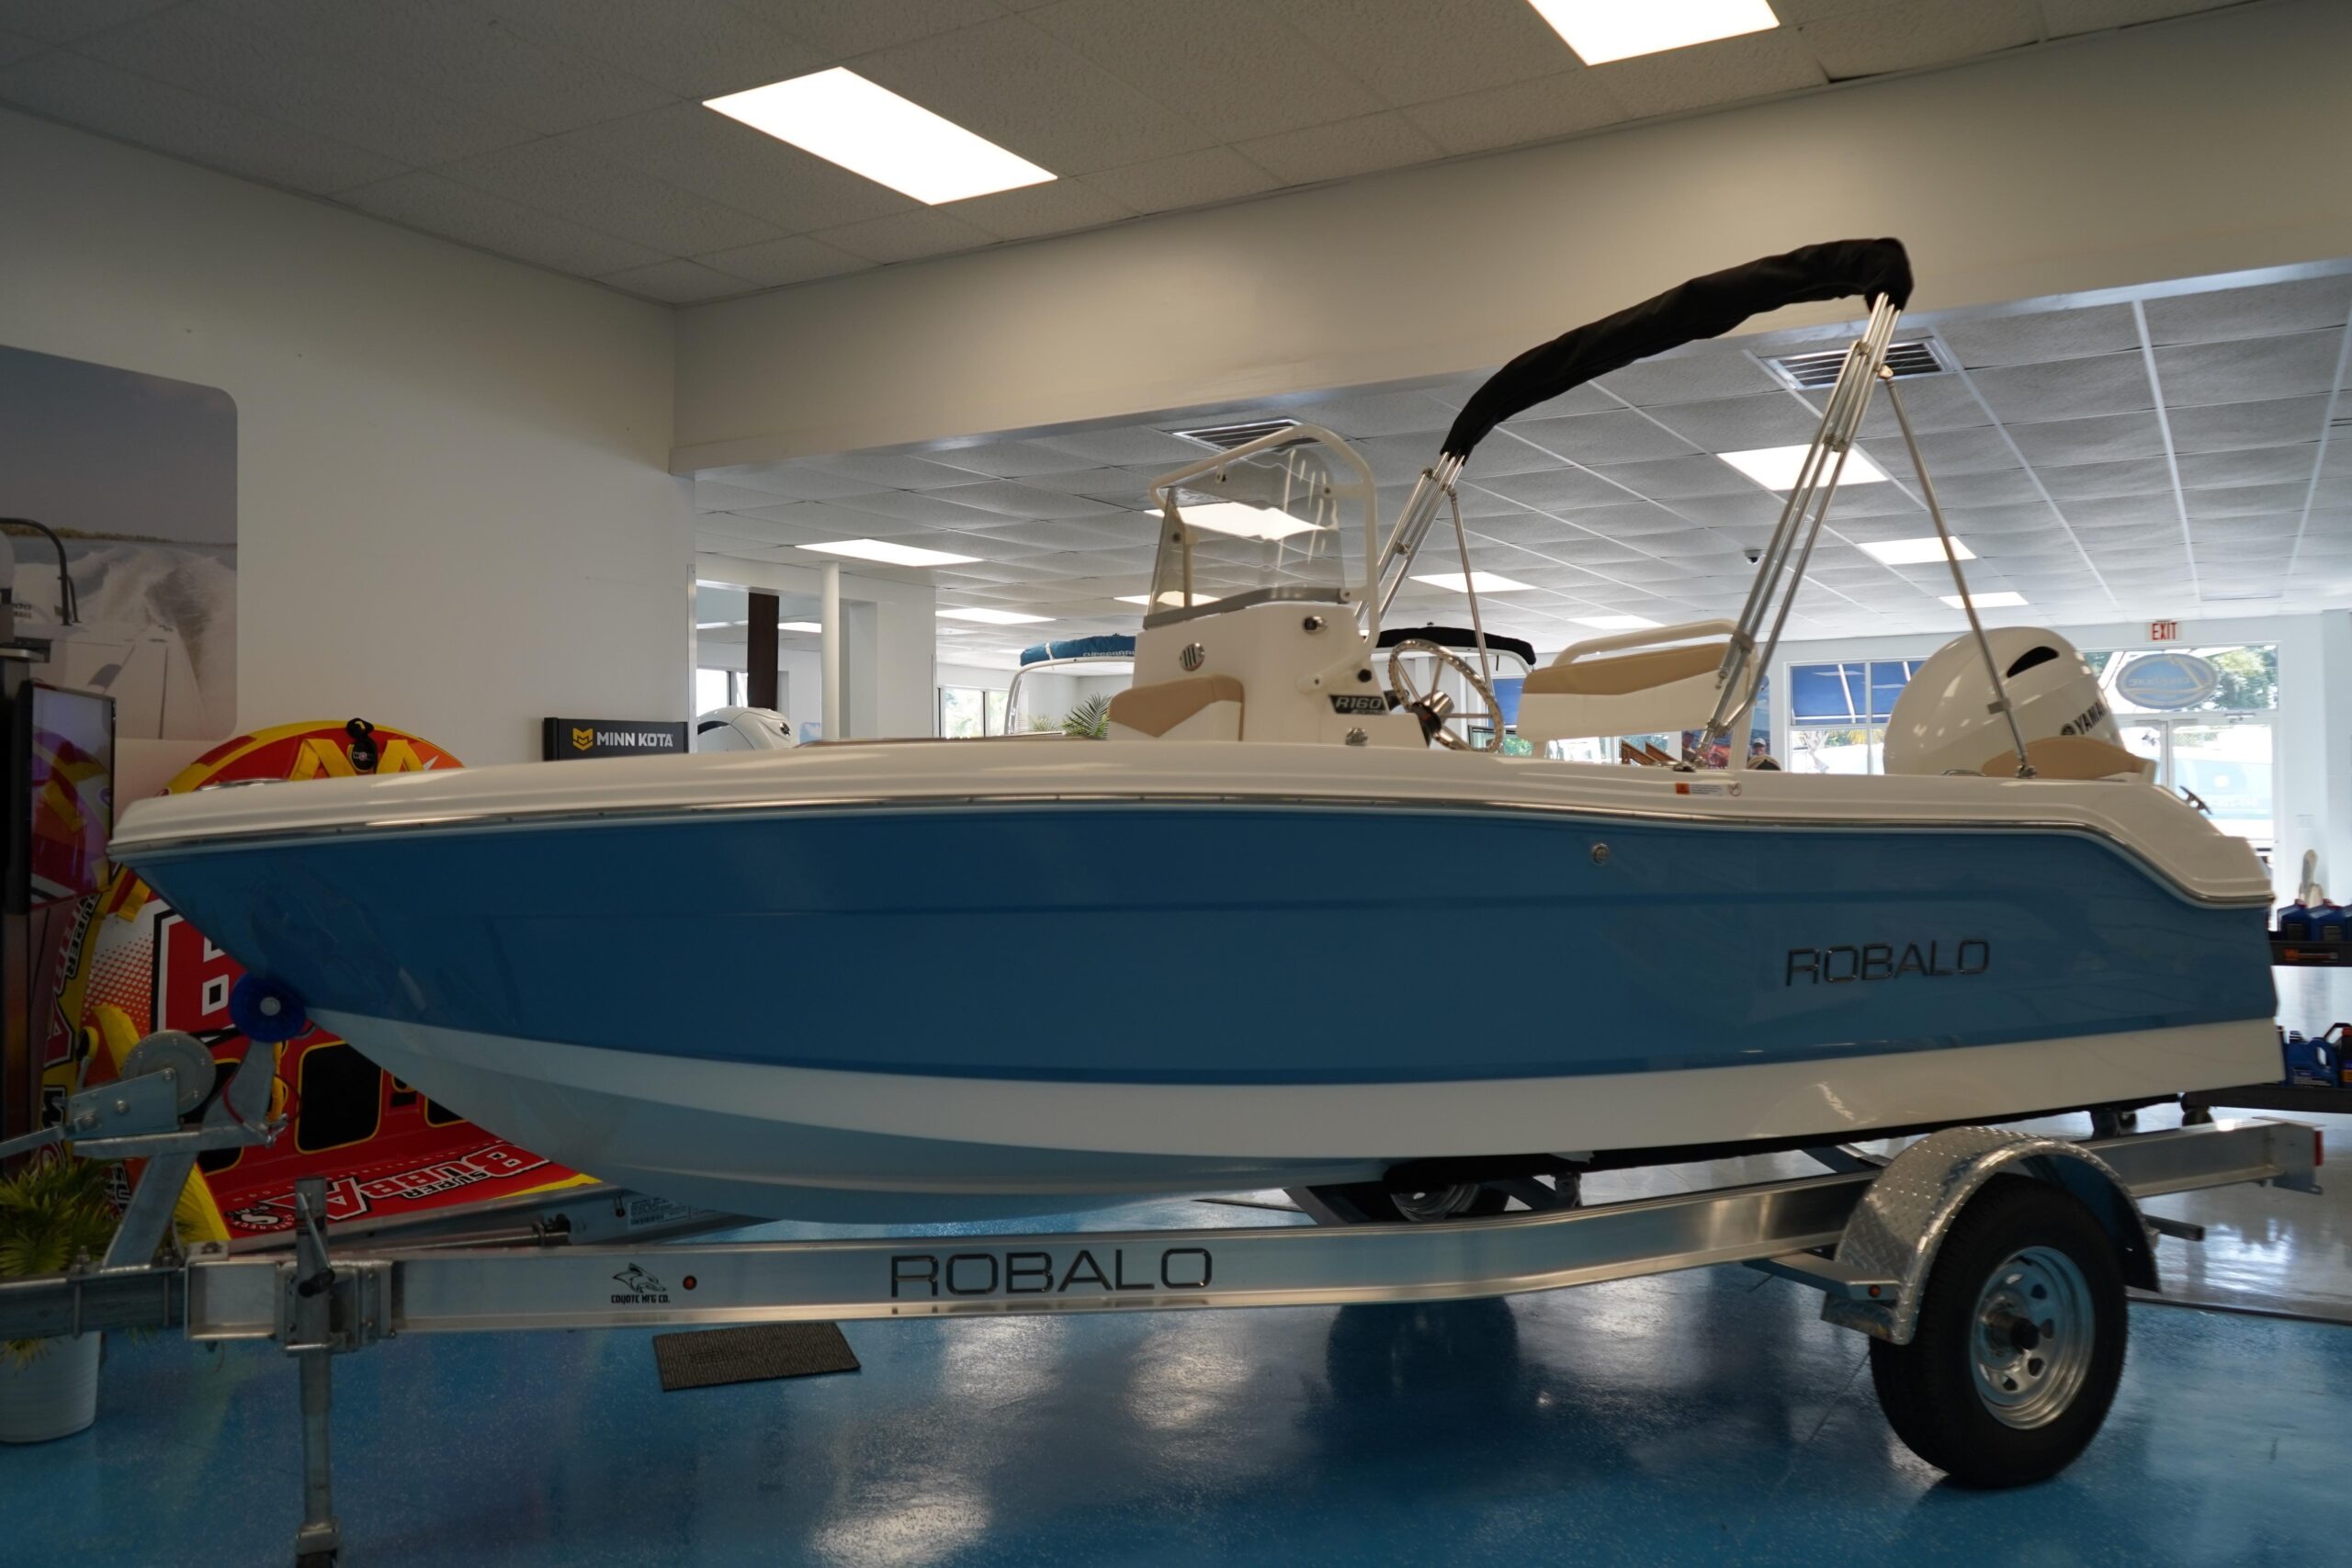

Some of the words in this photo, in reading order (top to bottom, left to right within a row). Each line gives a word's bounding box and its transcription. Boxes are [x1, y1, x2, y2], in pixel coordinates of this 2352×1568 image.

[2152, 622, 2177, 640] EXIT
[1335, 696, 1383, 709] R160
[596, 731, 635, 746] MINN
[639, 732, 673, 747] KOTA
[1786, 940, 1990, 987] ROBALO
[404, 1171, 487, 1199] SUPER
[890, 1247, 1213, 1297] ROBALO
[611, 1294, 639, 1305] COYOTE
